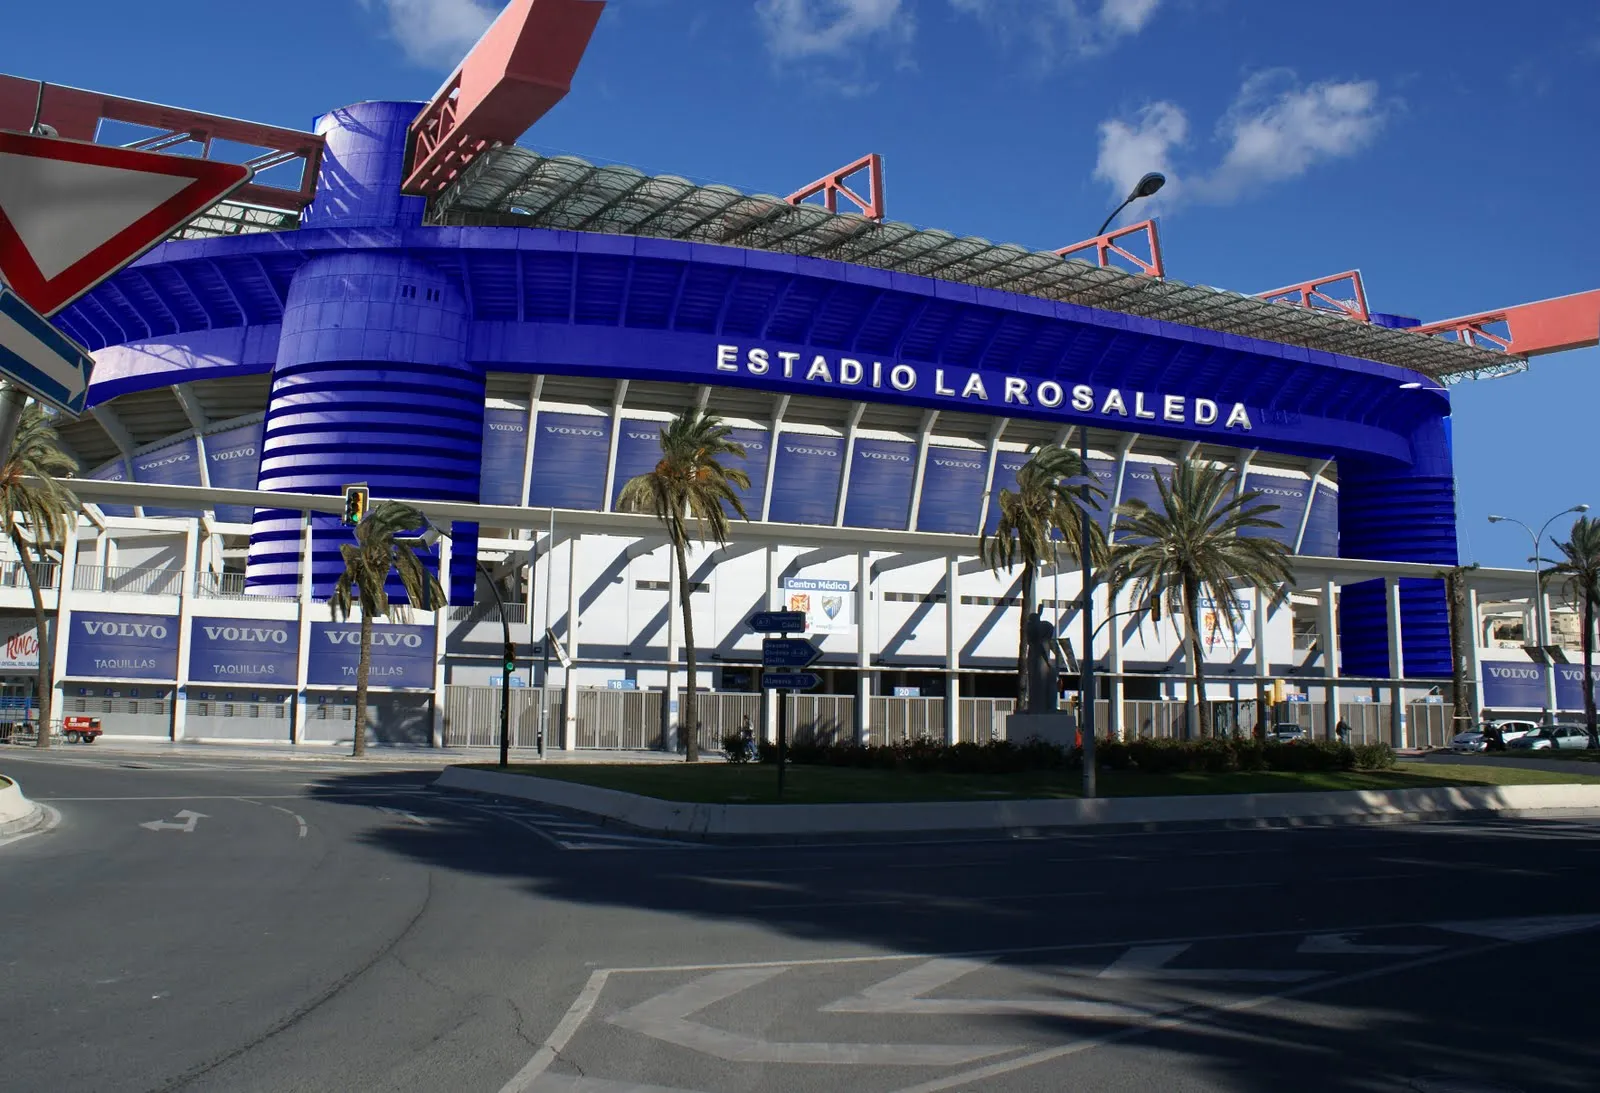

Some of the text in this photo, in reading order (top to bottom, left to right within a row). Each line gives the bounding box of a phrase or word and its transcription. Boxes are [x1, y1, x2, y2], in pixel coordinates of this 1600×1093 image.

[716, 343, 1253, 431] ESTADIO LA ROSALEDA
[488, 423, 524, 433] VOLVO
[544, 426, 604, 437] VOLVO
[627, 432, 661, 441] VOL
[211, 447, 255, 462] VOLVO
[784, 446, 838, 457] VOLVO
[860, 451, 910, 462] VOLVO
[139, 454, 190, 469] VOLVO
[933, 459, 982, 469] VOLVO
[1252, 486, 1303, 498] VOLVO
[787, 580, 848, 590] Centro Médico
[82, 621, 168, 639] VOLVO
[203, 626, 288, 644] VOLVO
[324, 630, 423, 648] VOLVO
[6, 632, 40, 660] RINCO
[94, 658, 156, 669] TAQUILLAS
[213, 664, 275, 675] TAQUILLAS
[1489, 667, 1540, 680] VOLVO
[1561, 670, 1600, 681] VOV
[899, 688, 910, 696] 20
